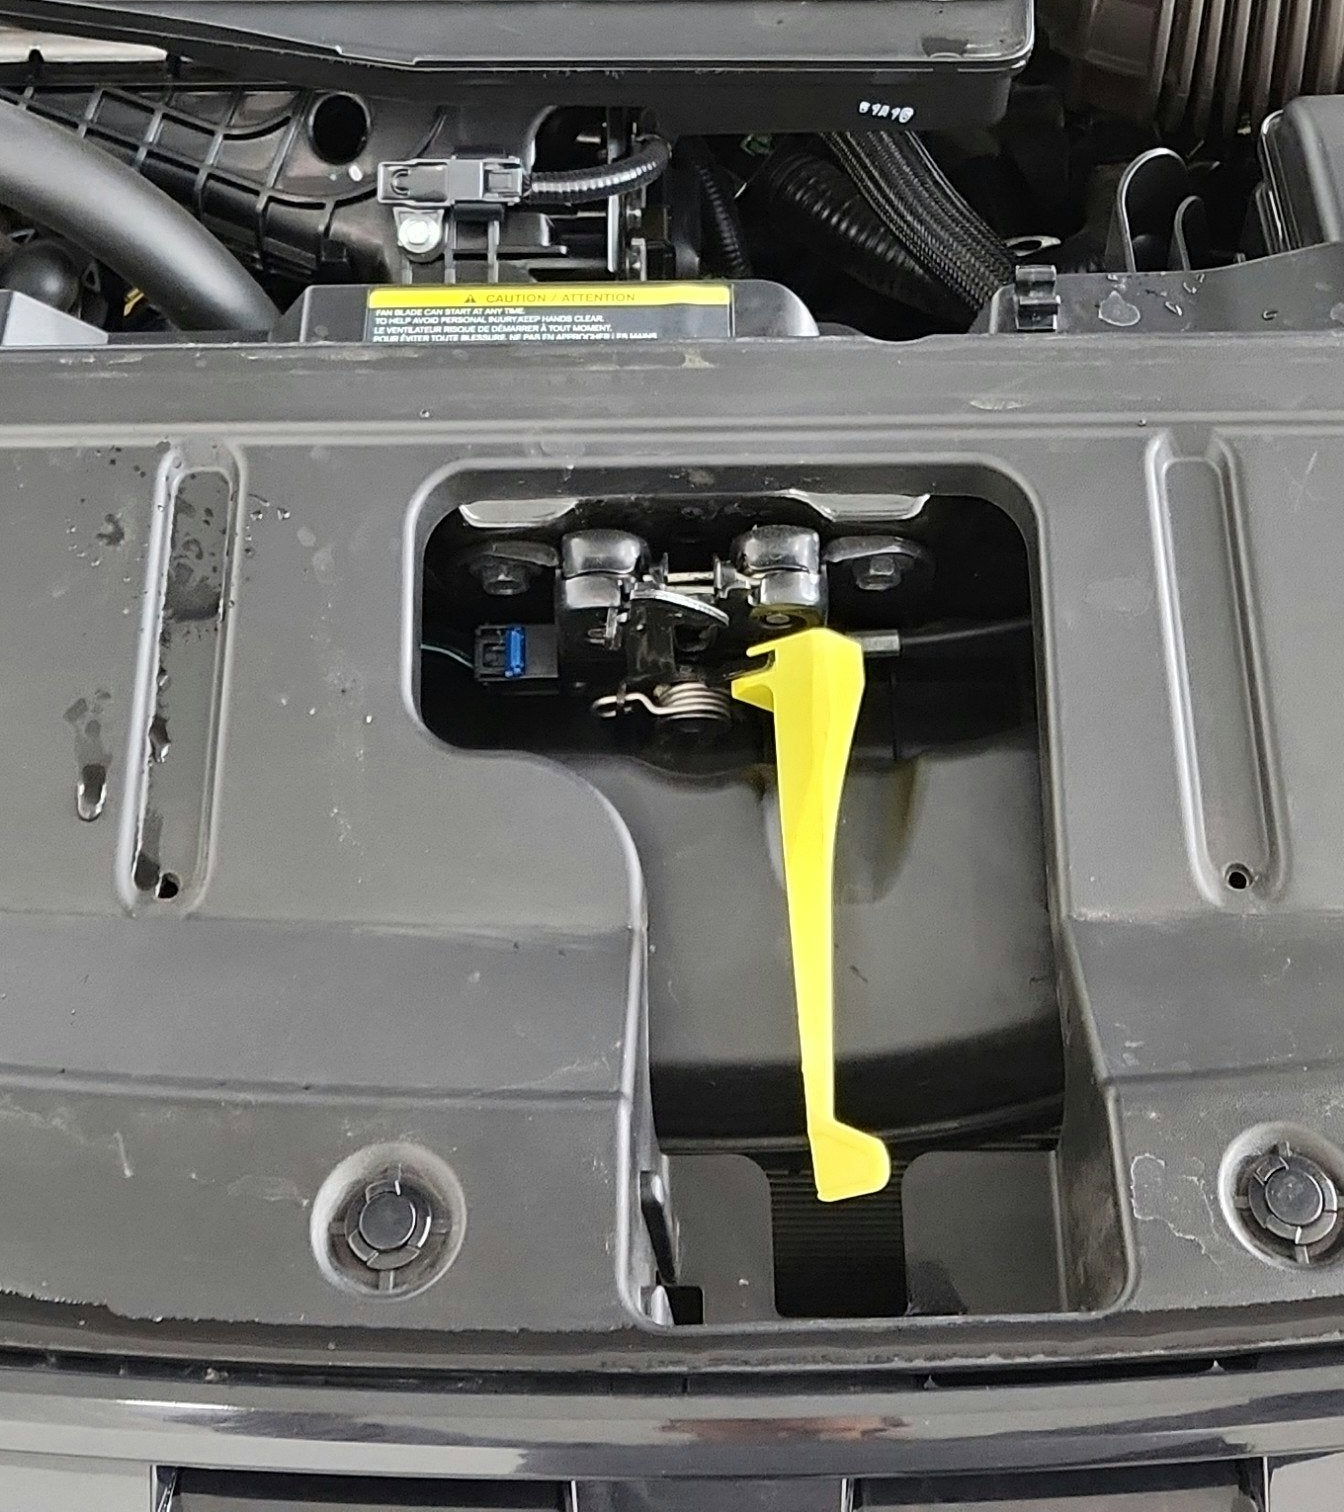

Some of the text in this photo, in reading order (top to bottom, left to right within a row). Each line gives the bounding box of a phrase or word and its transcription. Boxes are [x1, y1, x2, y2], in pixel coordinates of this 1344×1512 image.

[486, 294, 546, 303] CAUTION
[561, 293, 635, 302] ATTENTION
[394, 308, 422, 316] BLADE
[423, 308, 443, 316] CAN
[375, 317, 387, 325] TO
[388, 317, 411, 325] HELP
[440, 316, 487, 324] PERSONAL
[541, 315, 572, 323] HANDS
[373, 326, 386, 334] LE
[386, 326, 442, 334] VENTILATEUR
[443, 325, 476, 333] RISQUE
[477, 325, 490, 333] DE
[491, 324, 539, 333] DÉMARRER
[540, 323, 548, 332] À
[548, 324, 571, 332] TOUT
[399, 334, 430, 342] ÉVITER
[430, 334, 459, 342] TOUTE
